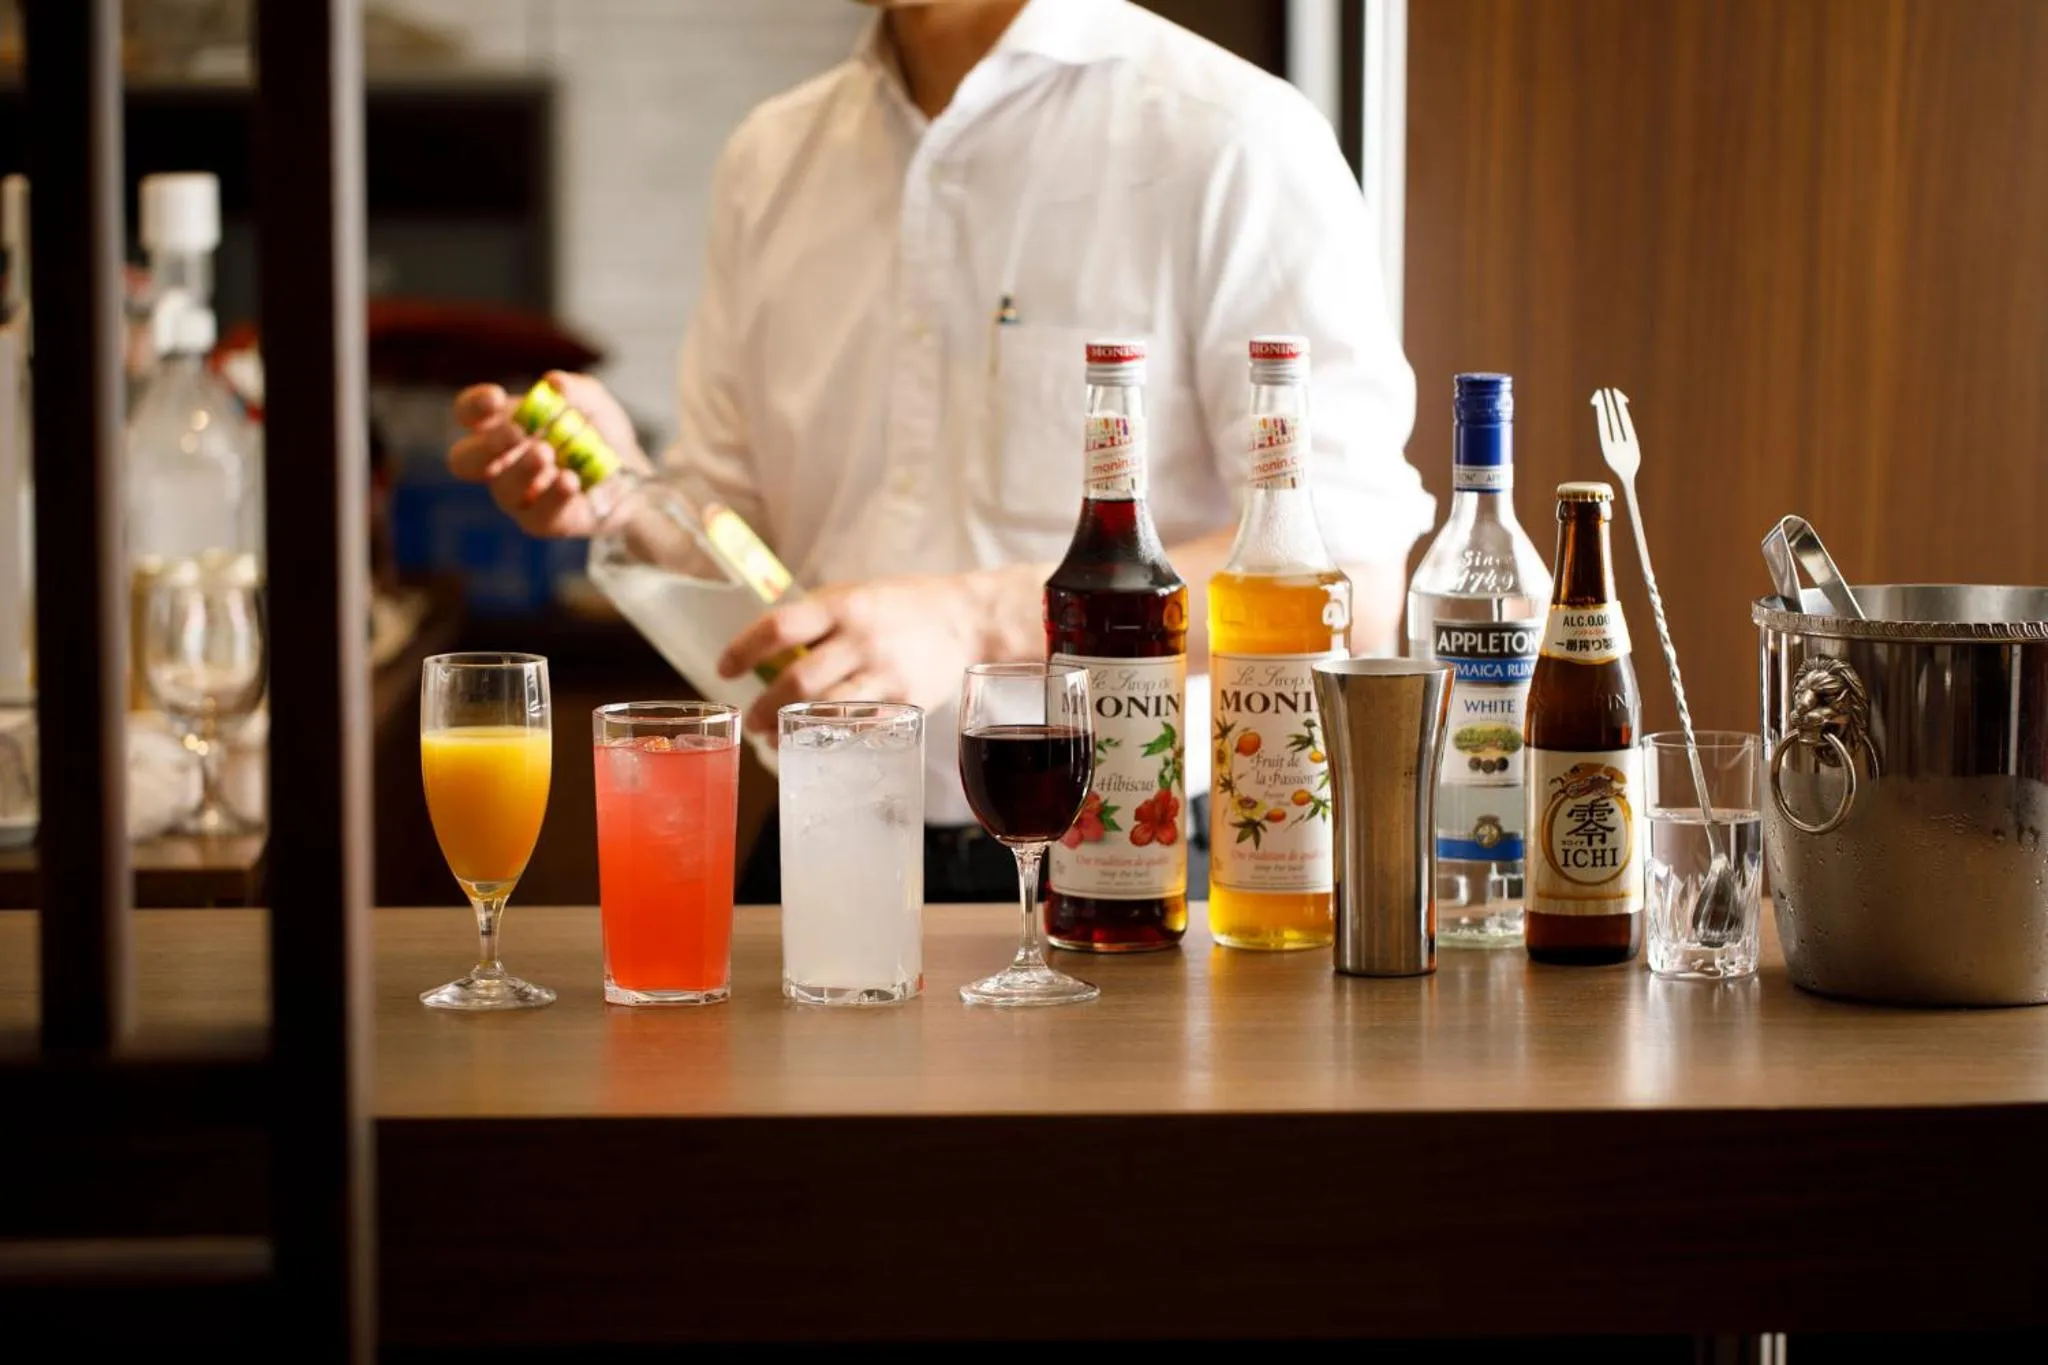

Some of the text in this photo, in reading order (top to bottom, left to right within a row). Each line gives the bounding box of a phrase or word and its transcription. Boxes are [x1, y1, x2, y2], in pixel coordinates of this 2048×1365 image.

[1457, 568, 1514, 593] 1749
[1437, 631, 1540, 654] APPLETON
[1456, 662, 1504, 678] MAICA
[1220, 688, 1318, 714] MONI
[1464, 699, 1516, 714] WHITE
[1251, 751, 1301, 770] Fruit de
[1096, 773, 1155, 793] Hibiscus
[1255, 770, 1313, 788] la Passion
[1566, 797, 1616, 847] 零
[1562, 848, 1619, 868] ICHI
